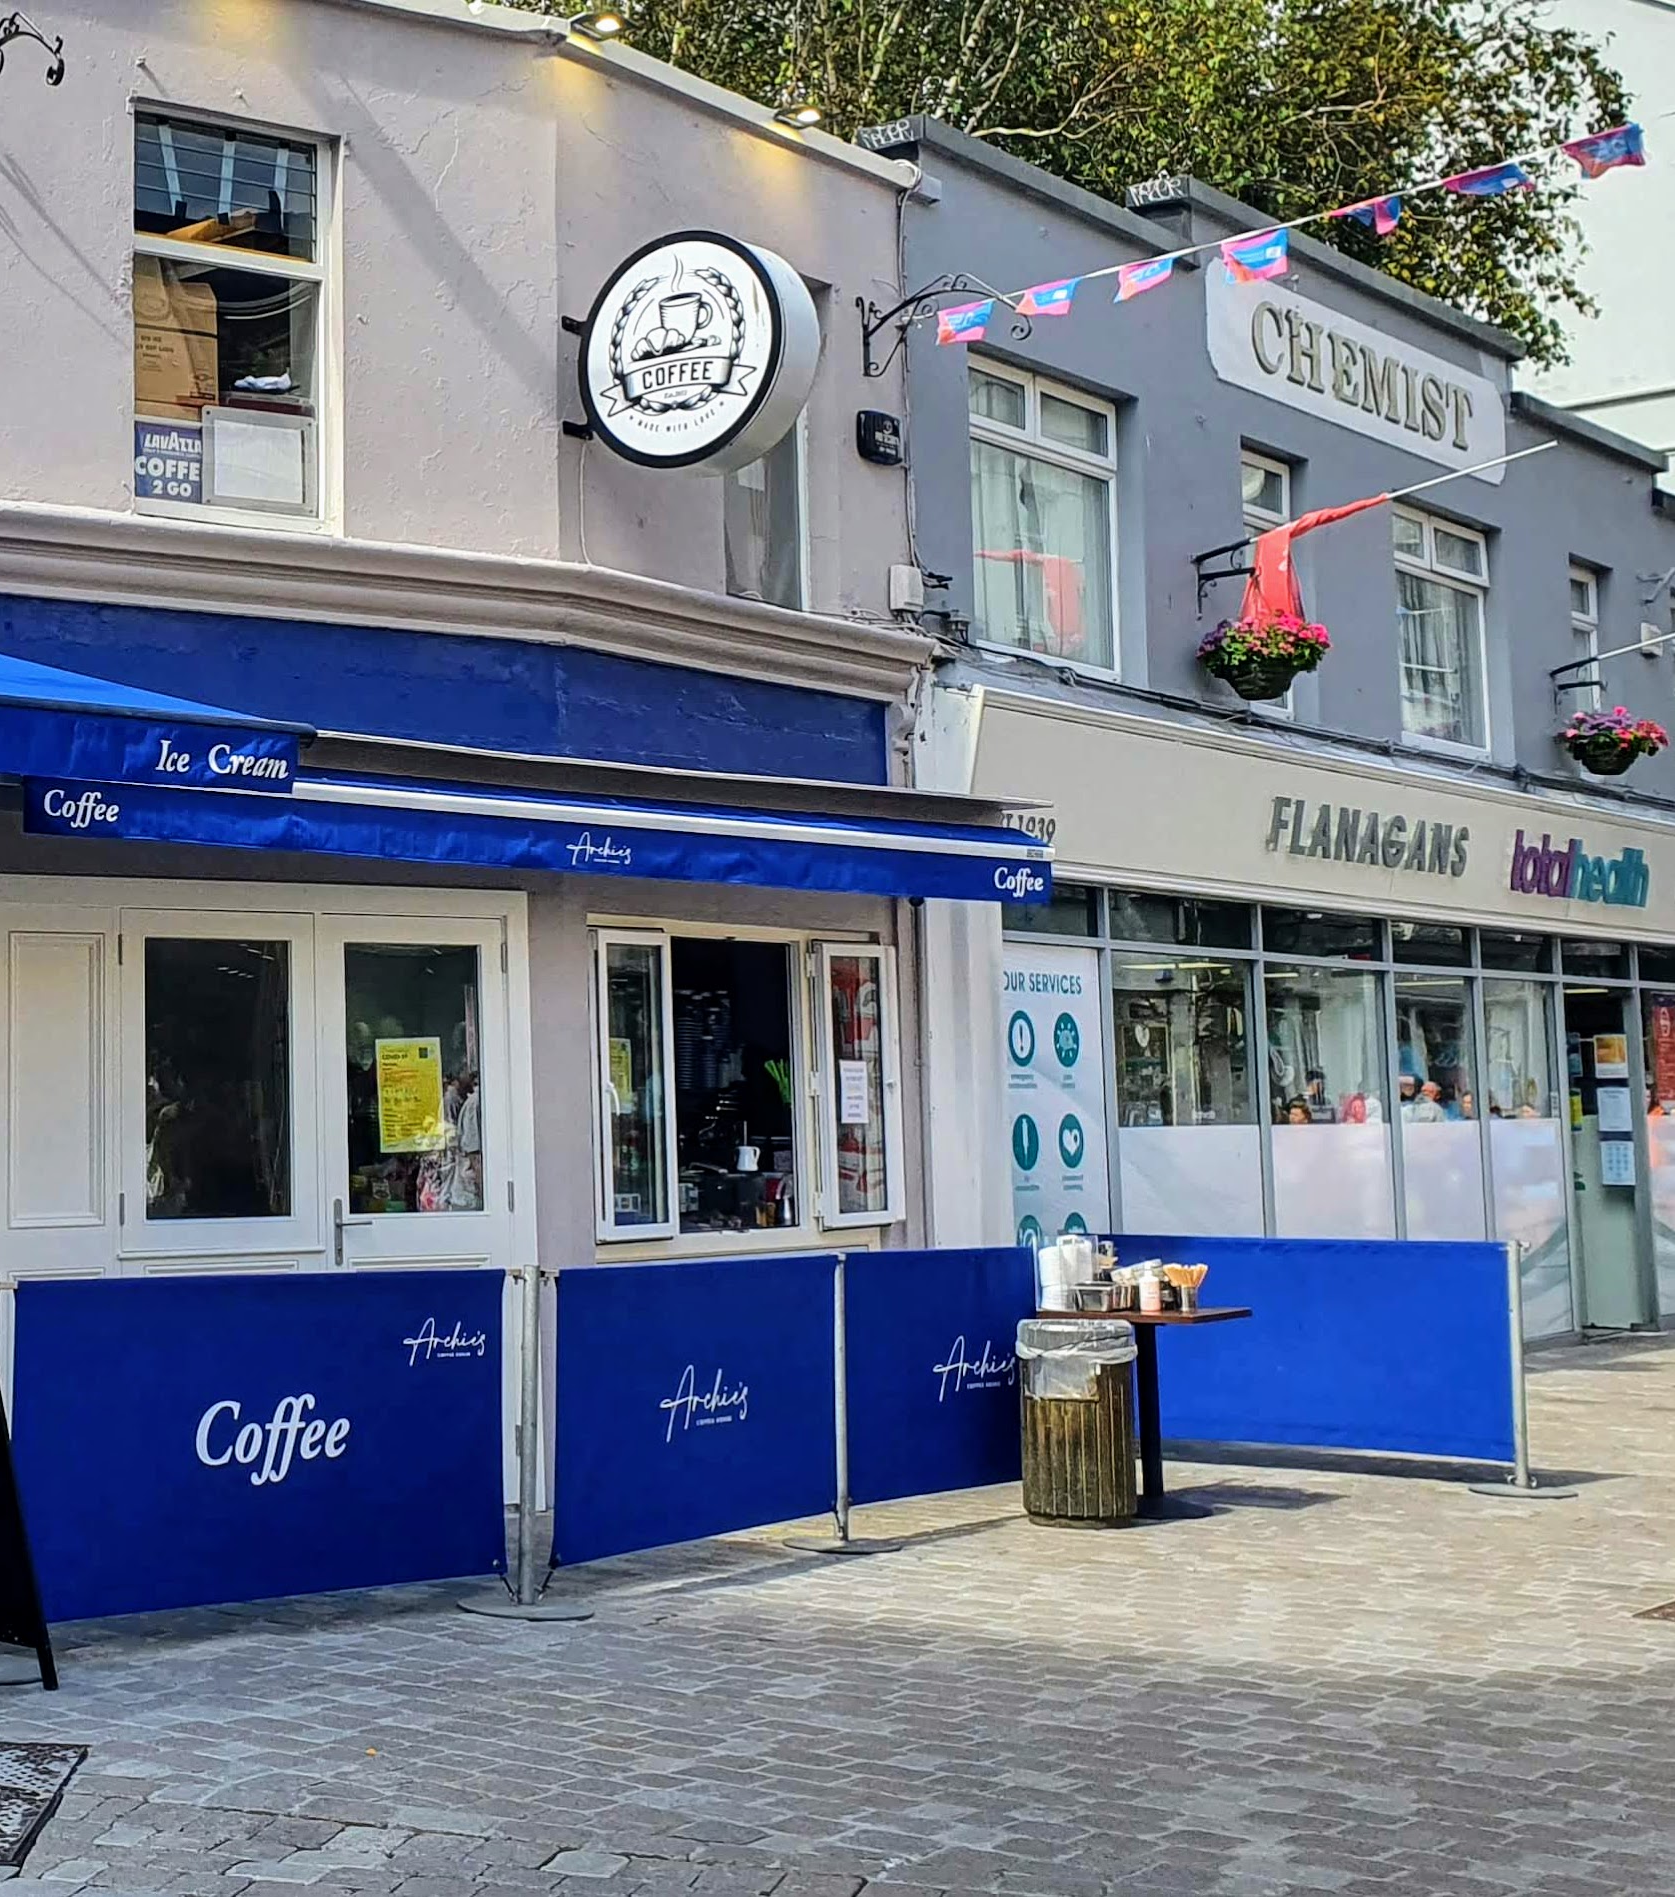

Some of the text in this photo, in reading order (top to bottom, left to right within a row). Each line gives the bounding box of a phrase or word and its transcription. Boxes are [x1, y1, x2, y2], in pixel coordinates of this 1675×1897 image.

[642, 360, 714, 390] COFFEE
[1251, 300, 1473, 451] CHEMIST
[143, 431, 202, 454] LAVAZZA
[152, 479, 192, 497] 2 GO
[154, 739, 289, 779] Ice Cream
[43, 789, 120, 828] Coffee
[1268, 796, 1470, 878] FLANAGANS
[994, 866, 1044, 898] Coffee
[1029, 972, 1083, 995] SERVICES
[403, 1316, 486, 1367] Archie's
[659, 1364, 748, 1443] Archie's
[195, 1392, 351, 1486] Coffee
